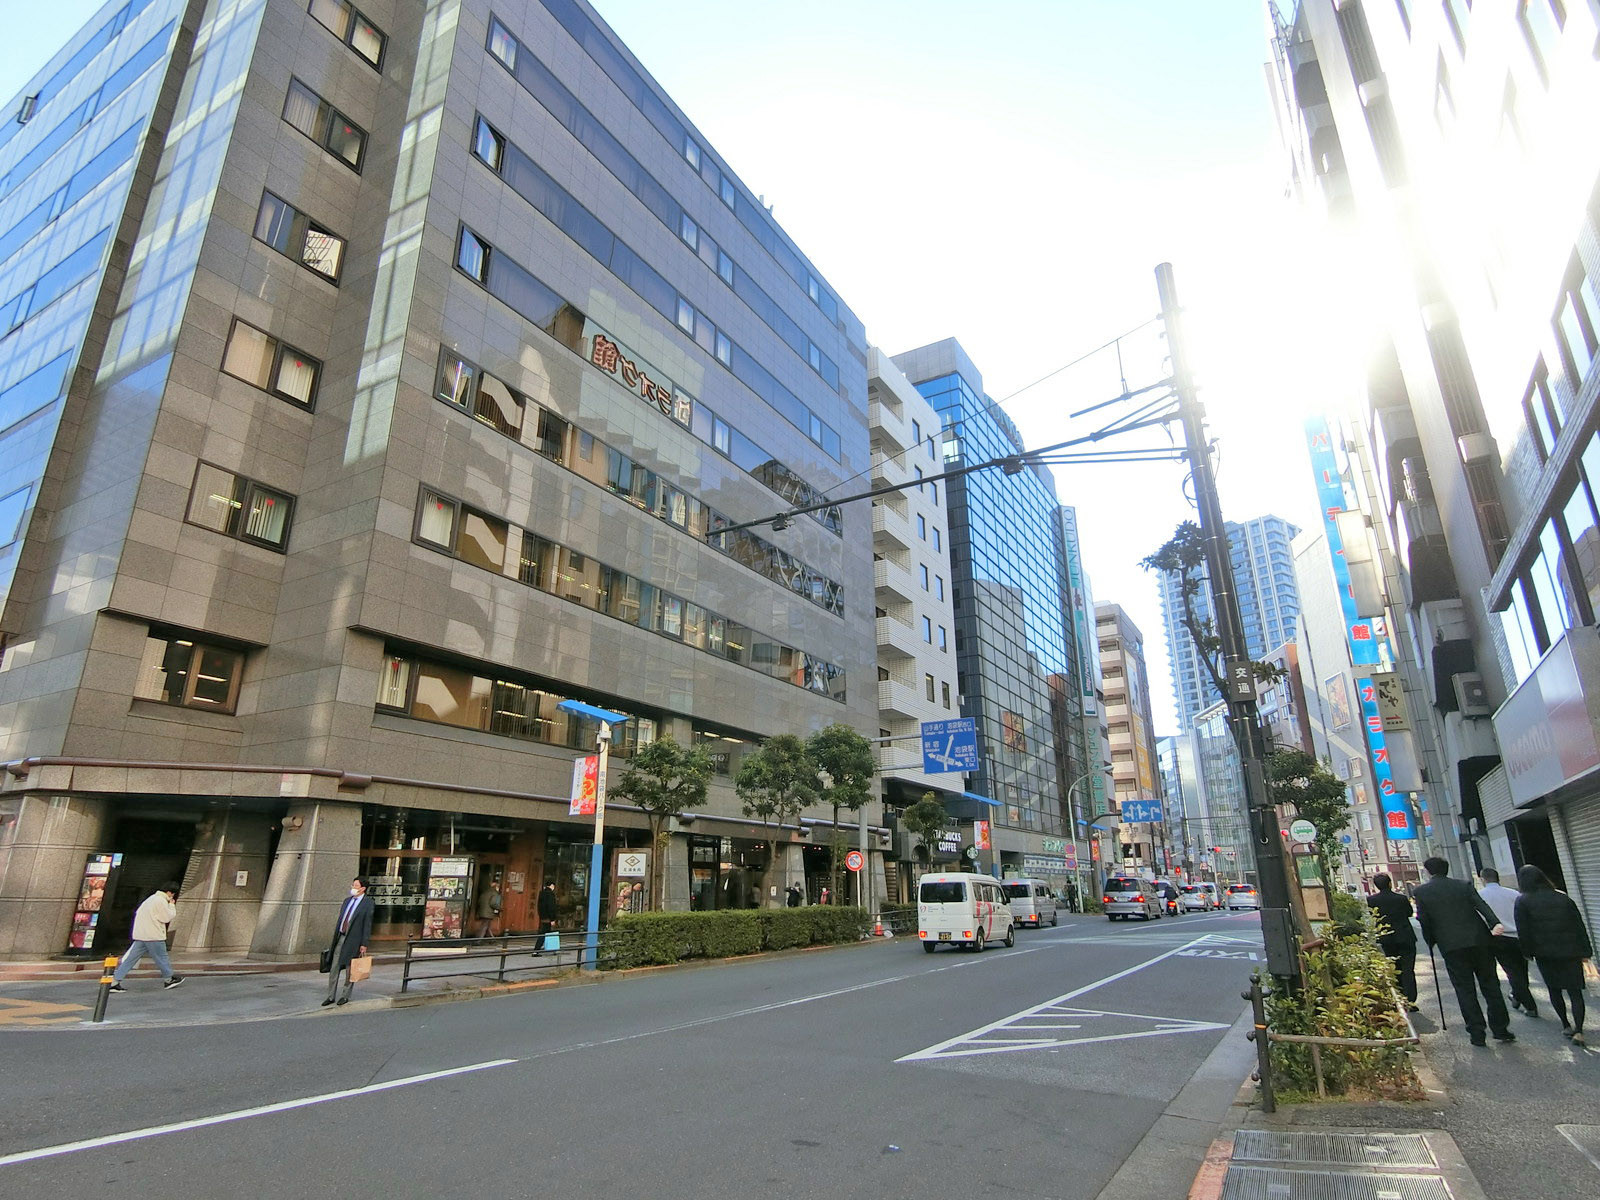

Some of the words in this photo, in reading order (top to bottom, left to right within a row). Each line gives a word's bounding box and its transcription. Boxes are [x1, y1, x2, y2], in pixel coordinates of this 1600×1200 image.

[1063, 509, 1081, 587] JUNKUDO
[1235, 667, 1250, 694] 交通
[1379, 681, 1398, 707] てんや
[955, 745, 975, 753] 池袋駅
[1087, 727, 1106, 816] ジュンク堂書店
[938, 841, 957, 852] COFFEE
